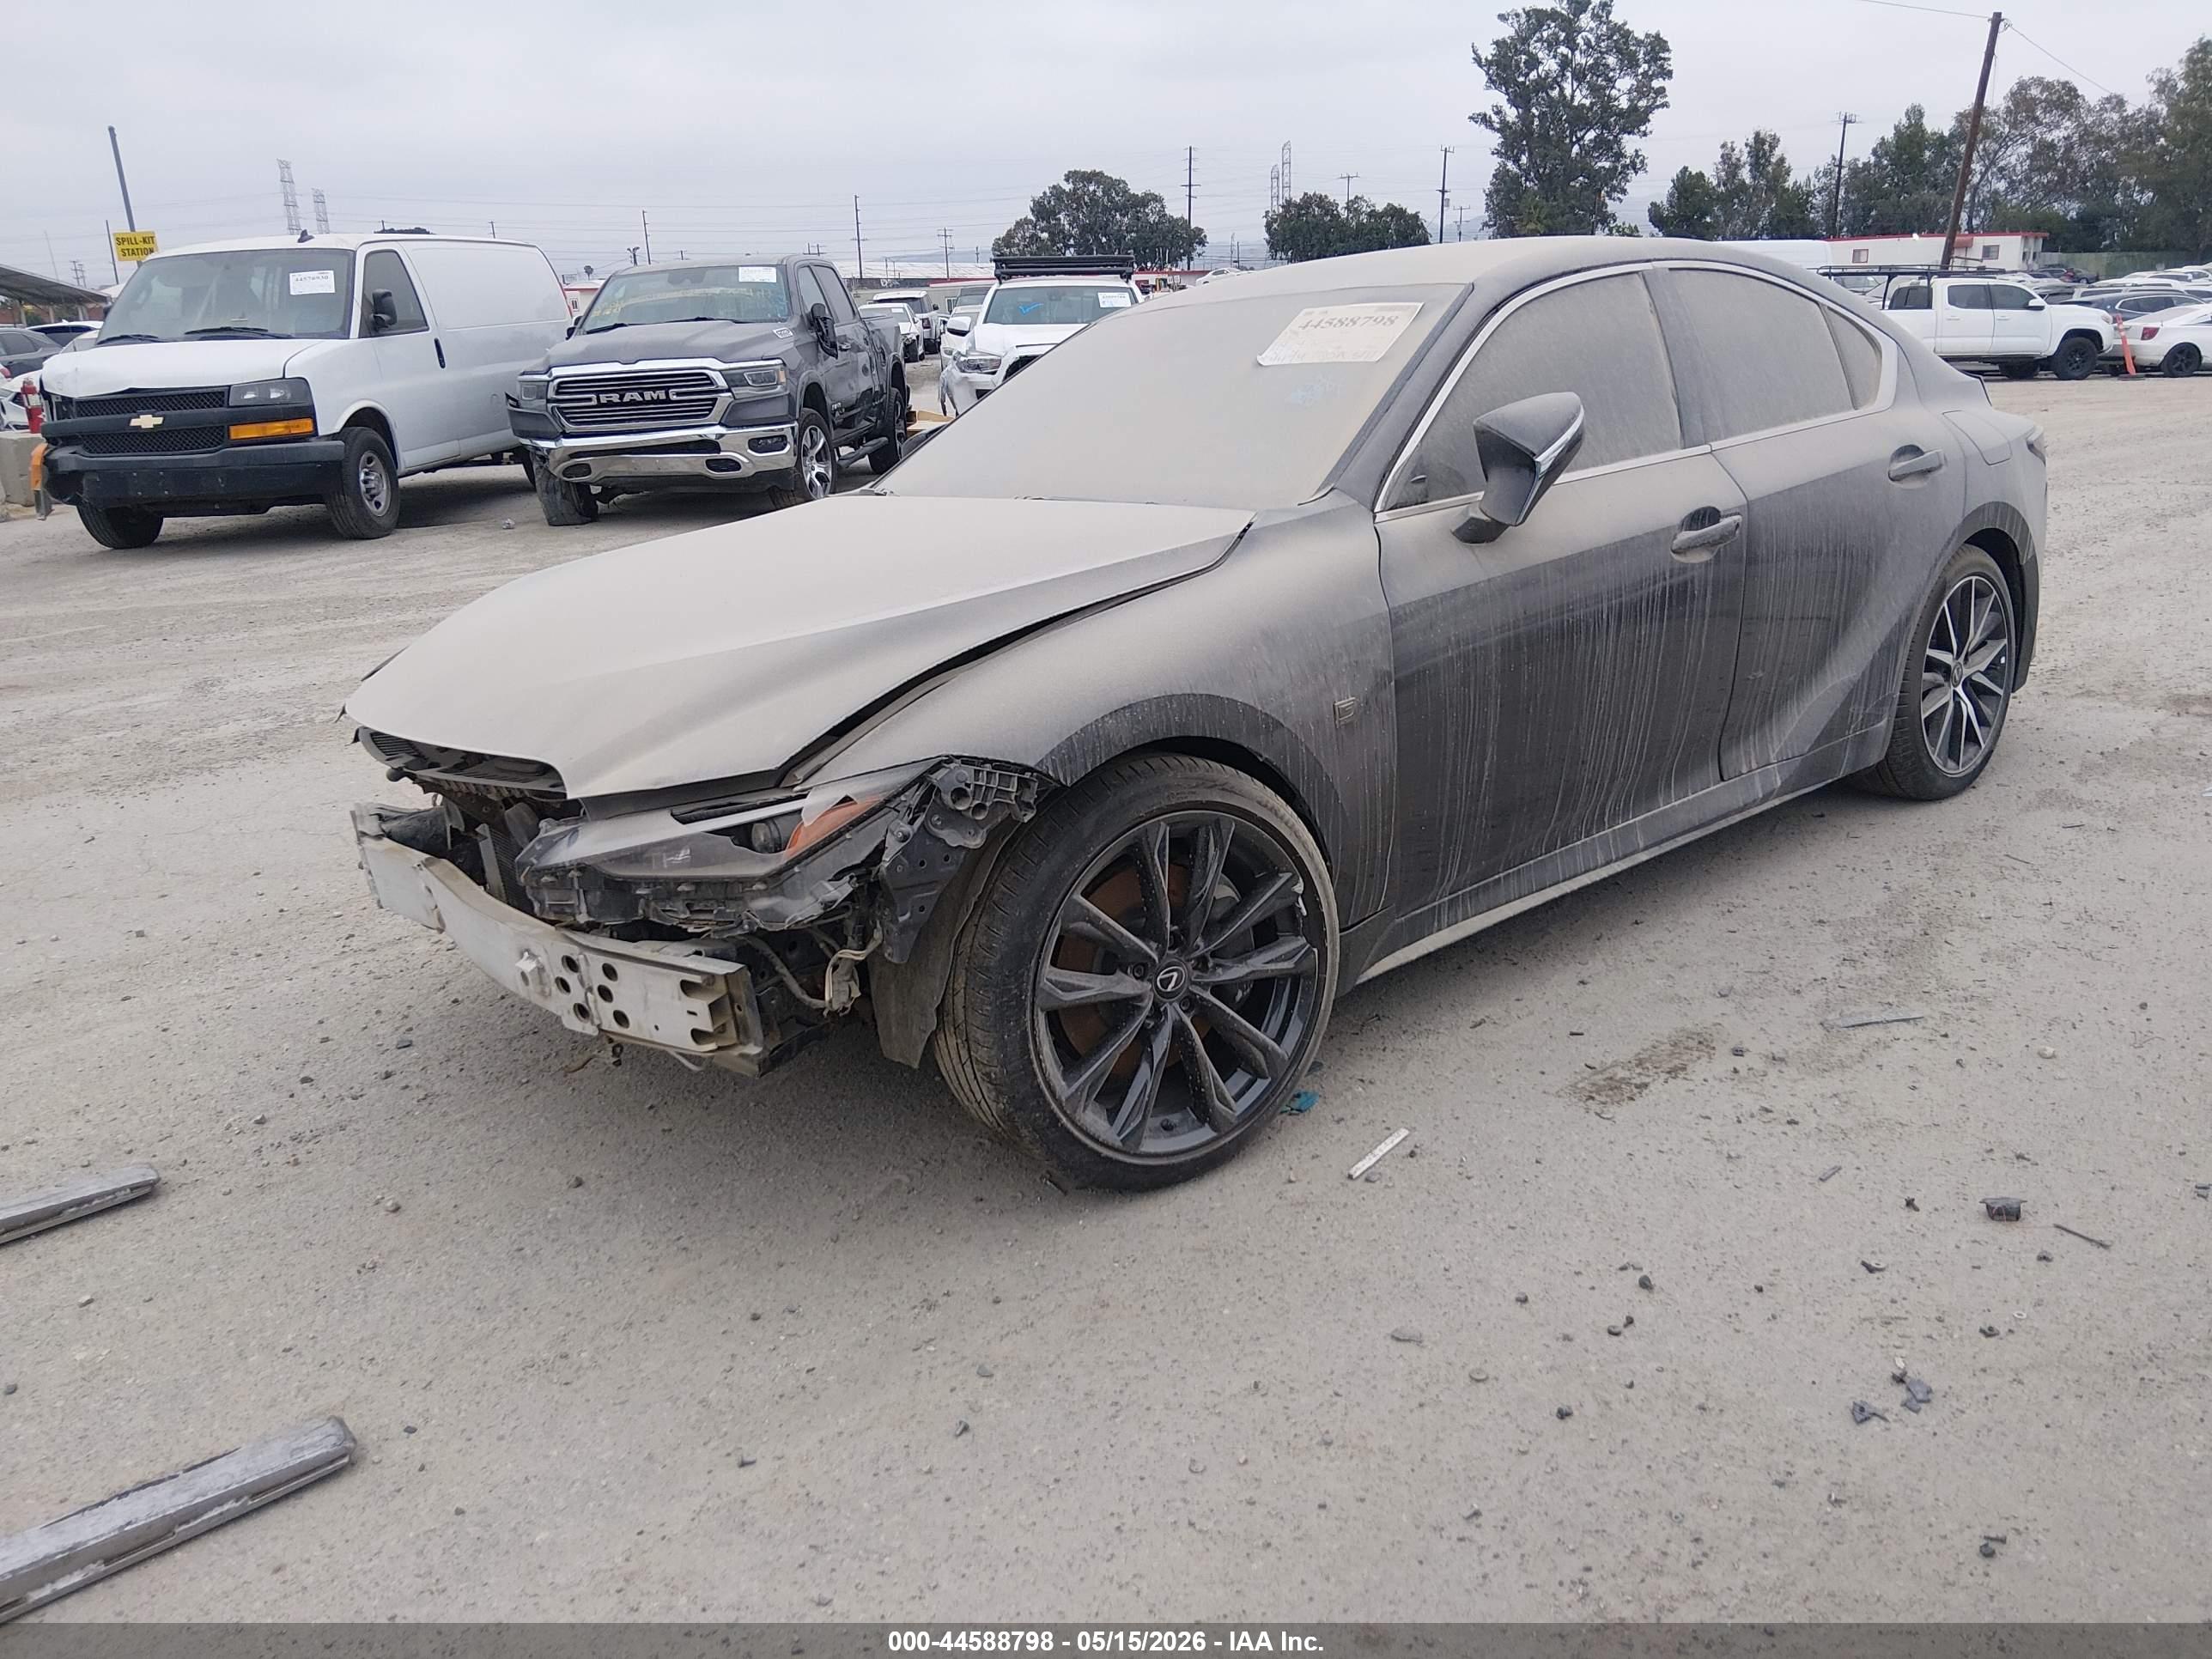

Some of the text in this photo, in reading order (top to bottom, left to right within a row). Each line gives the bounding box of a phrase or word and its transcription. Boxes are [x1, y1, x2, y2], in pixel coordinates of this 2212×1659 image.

[116, 235, 155, 246] SPILL-KIT
[120, 247, 155, 257] STATION
[1297, 315, 1400, 331] 44588798
[599, 390, 666, 404] RAM
